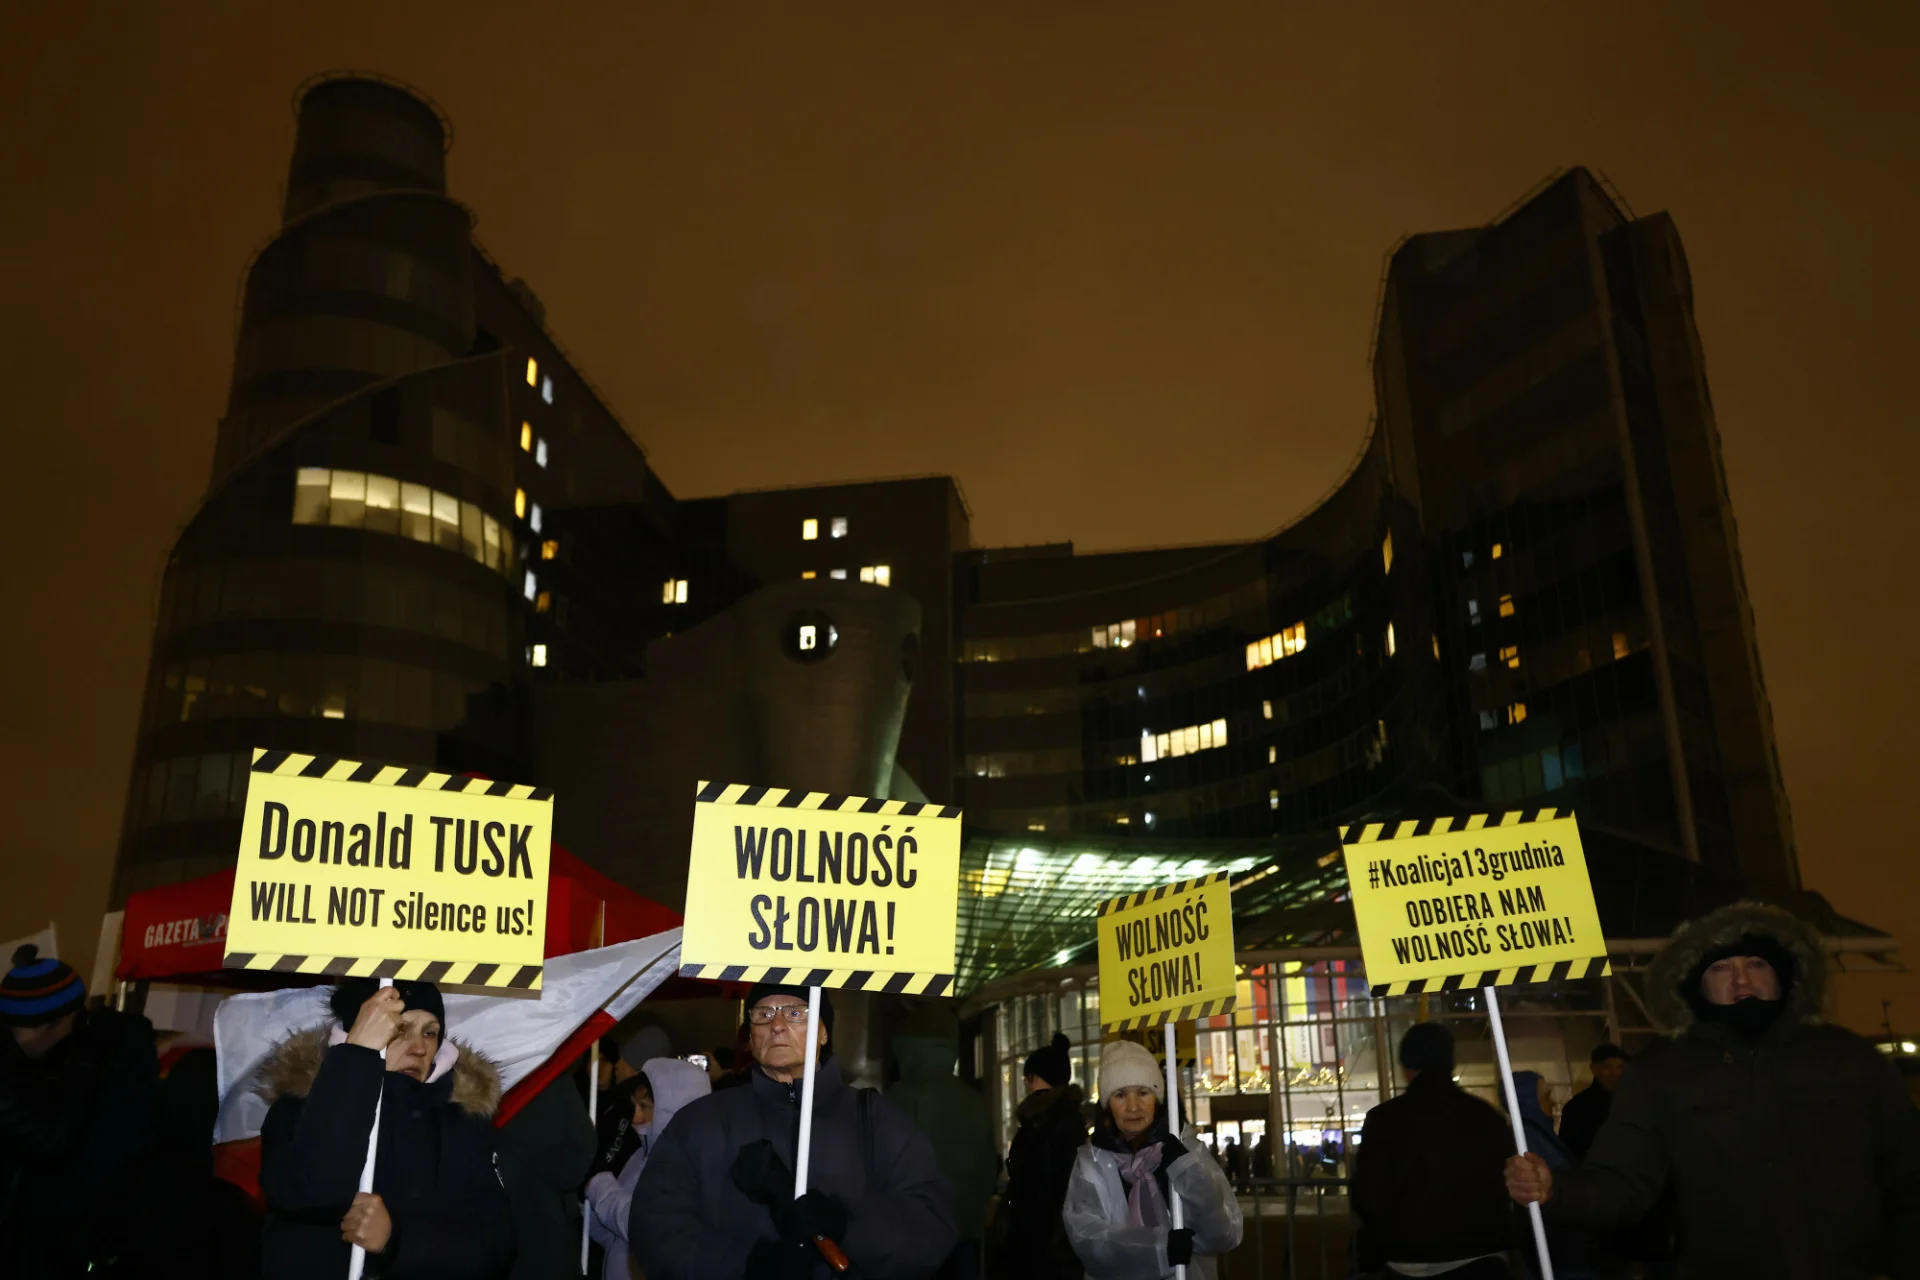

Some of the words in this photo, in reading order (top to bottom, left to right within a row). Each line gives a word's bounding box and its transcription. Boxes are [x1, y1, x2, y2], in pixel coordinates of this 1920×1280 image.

[258, 801, 413, 870] Donald
[430, 816, 534, 879] TUSK
[734, 824, 918, 889] WOLNOŚĆ
[1368, 840, 1565, 890] #Koalicja13grudnia
[144, 918, 199, 949] GAZETA
[250, 881, 317, 924] WILL
[327, 885, 385, 928] NOT
[392, 892, 486, 933] silence
[496, 899, 534, 936] us!
[748, 894, 896, 955] SŁOWA!
[1115, 894, 1210, 962] WOLNOŚĆ
[1405, 892, 1495, 928] ODBIERA
[1498, 885, 1547, 917] NAM
[1391, 922, 1492, 965] WOLNOŚĆ
[1496, 916, 1575, 952] SŁOWA!
[1127, 952, 1203, 1007] SŁOWA!
